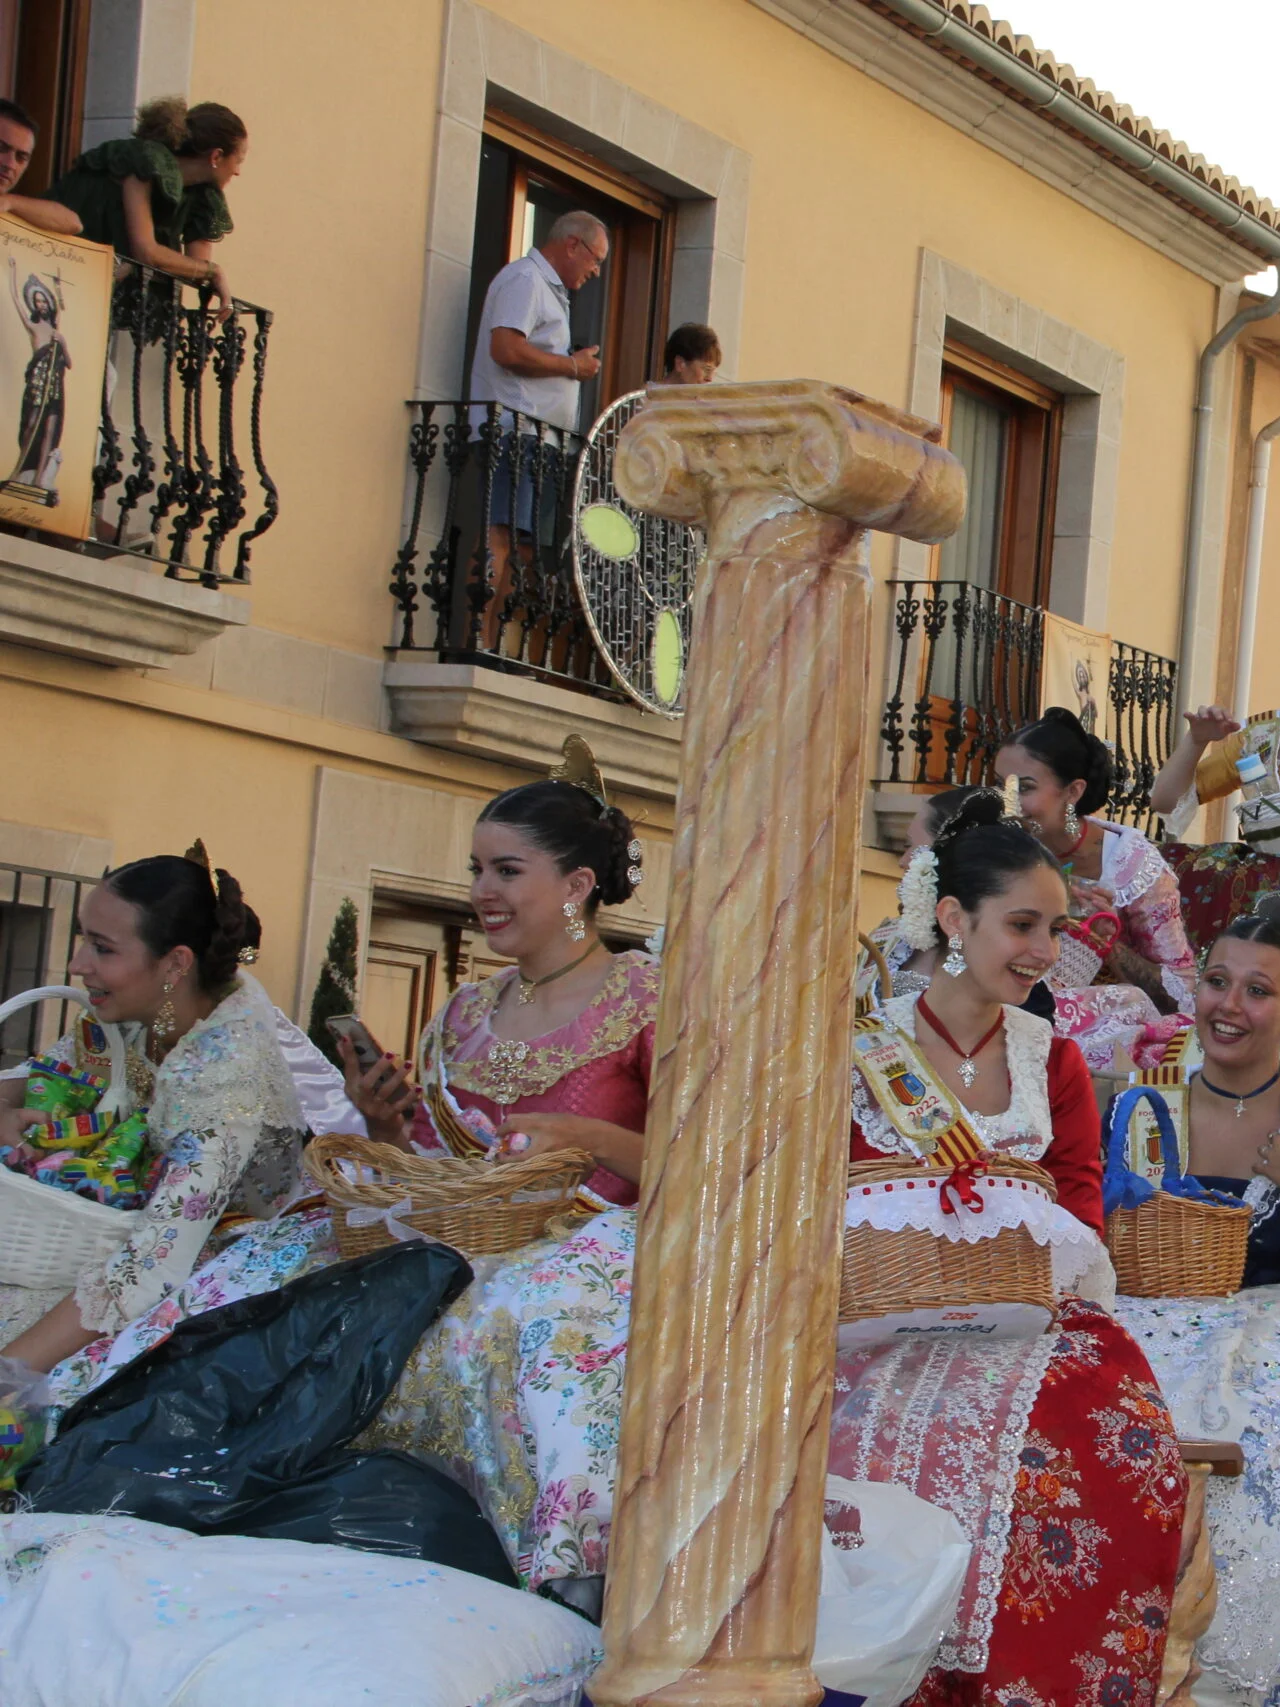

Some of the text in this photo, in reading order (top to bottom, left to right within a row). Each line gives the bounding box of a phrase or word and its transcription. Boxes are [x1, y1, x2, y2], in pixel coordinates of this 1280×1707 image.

[83, 1052, 112, 1067] 2022
[907, 1095, 941, 1119] 2022
[941, 1312, 979, 1321] 2022
